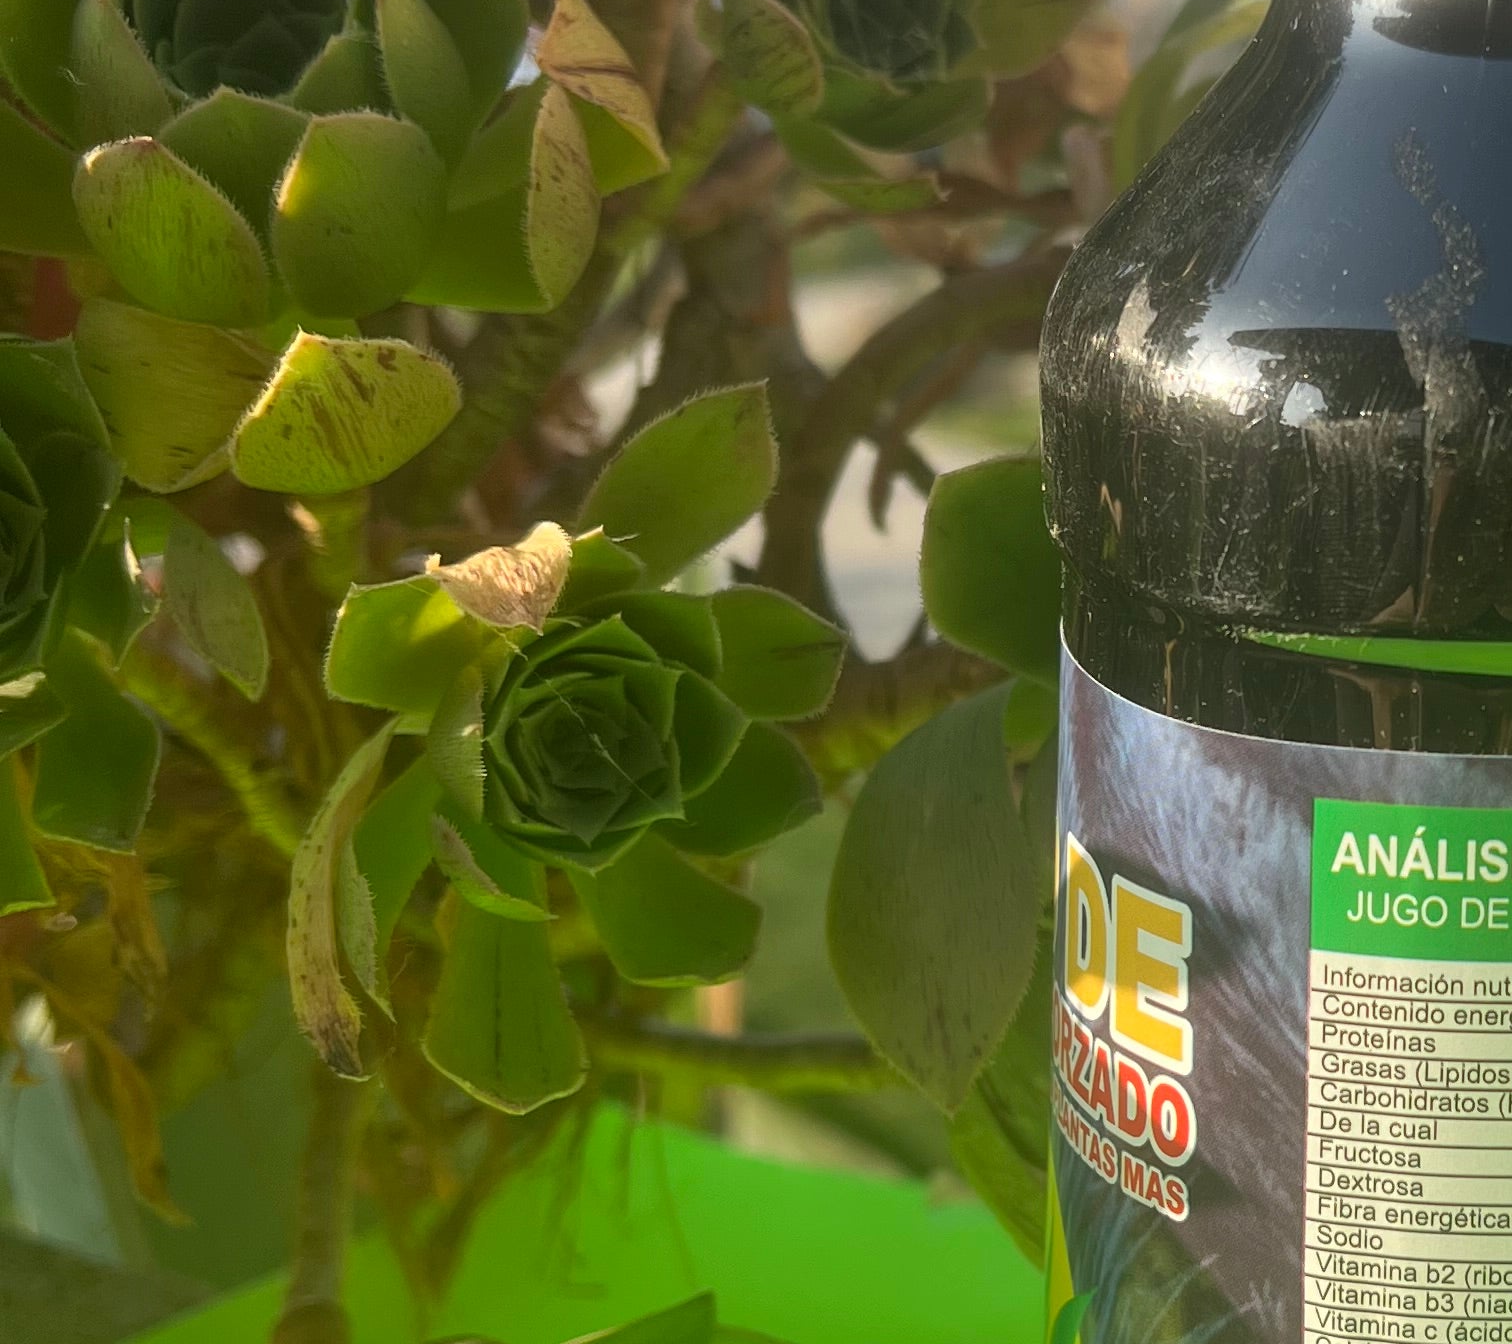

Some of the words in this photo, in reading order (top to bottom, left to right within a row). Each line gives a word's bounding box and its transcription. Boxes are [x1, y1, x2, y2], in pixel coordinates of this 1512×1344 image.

[1347, 890, 1448, 927] JUGO
[1461, 897, 1510, 929] DE
[1066, 832, 1193, 1076] DE
[1323, 964, 1465, 996] Información
[1322, 994, 1445, 1025] Contenido
[1321, 1053, 1406, 1081] Grasas
[1320, 1082, 1489, 1114] Carbohidratos
[1320, 1111, 1352, 1133] De
[1361, 1115, 1380, 1136] la
[1389, 1120, 1438, 1141] cual
[1319, 1139, 1422, 1168] Fructosa
[1121, 1150, 1189, 1222] MAS
[1318, 1167, 1424, 1197] Dextrosa
[1317, 1196, 1376, 1222] Fibra
[1385, 1207, 1511, 1232] energética
[1316, 1225, 1383, 1251] Sodio
[1316, 1252, 1417, 1283] Vitamina
[1426, 1264, 1455, 1285] b2
[1315, 1280, 1416, 1311] Vitamina
[1425, 1292, 1454, 1313] b3
[1315, 1308, 1415, 1339] Vitamina
[1424, 1326, 1438, 1341] c
